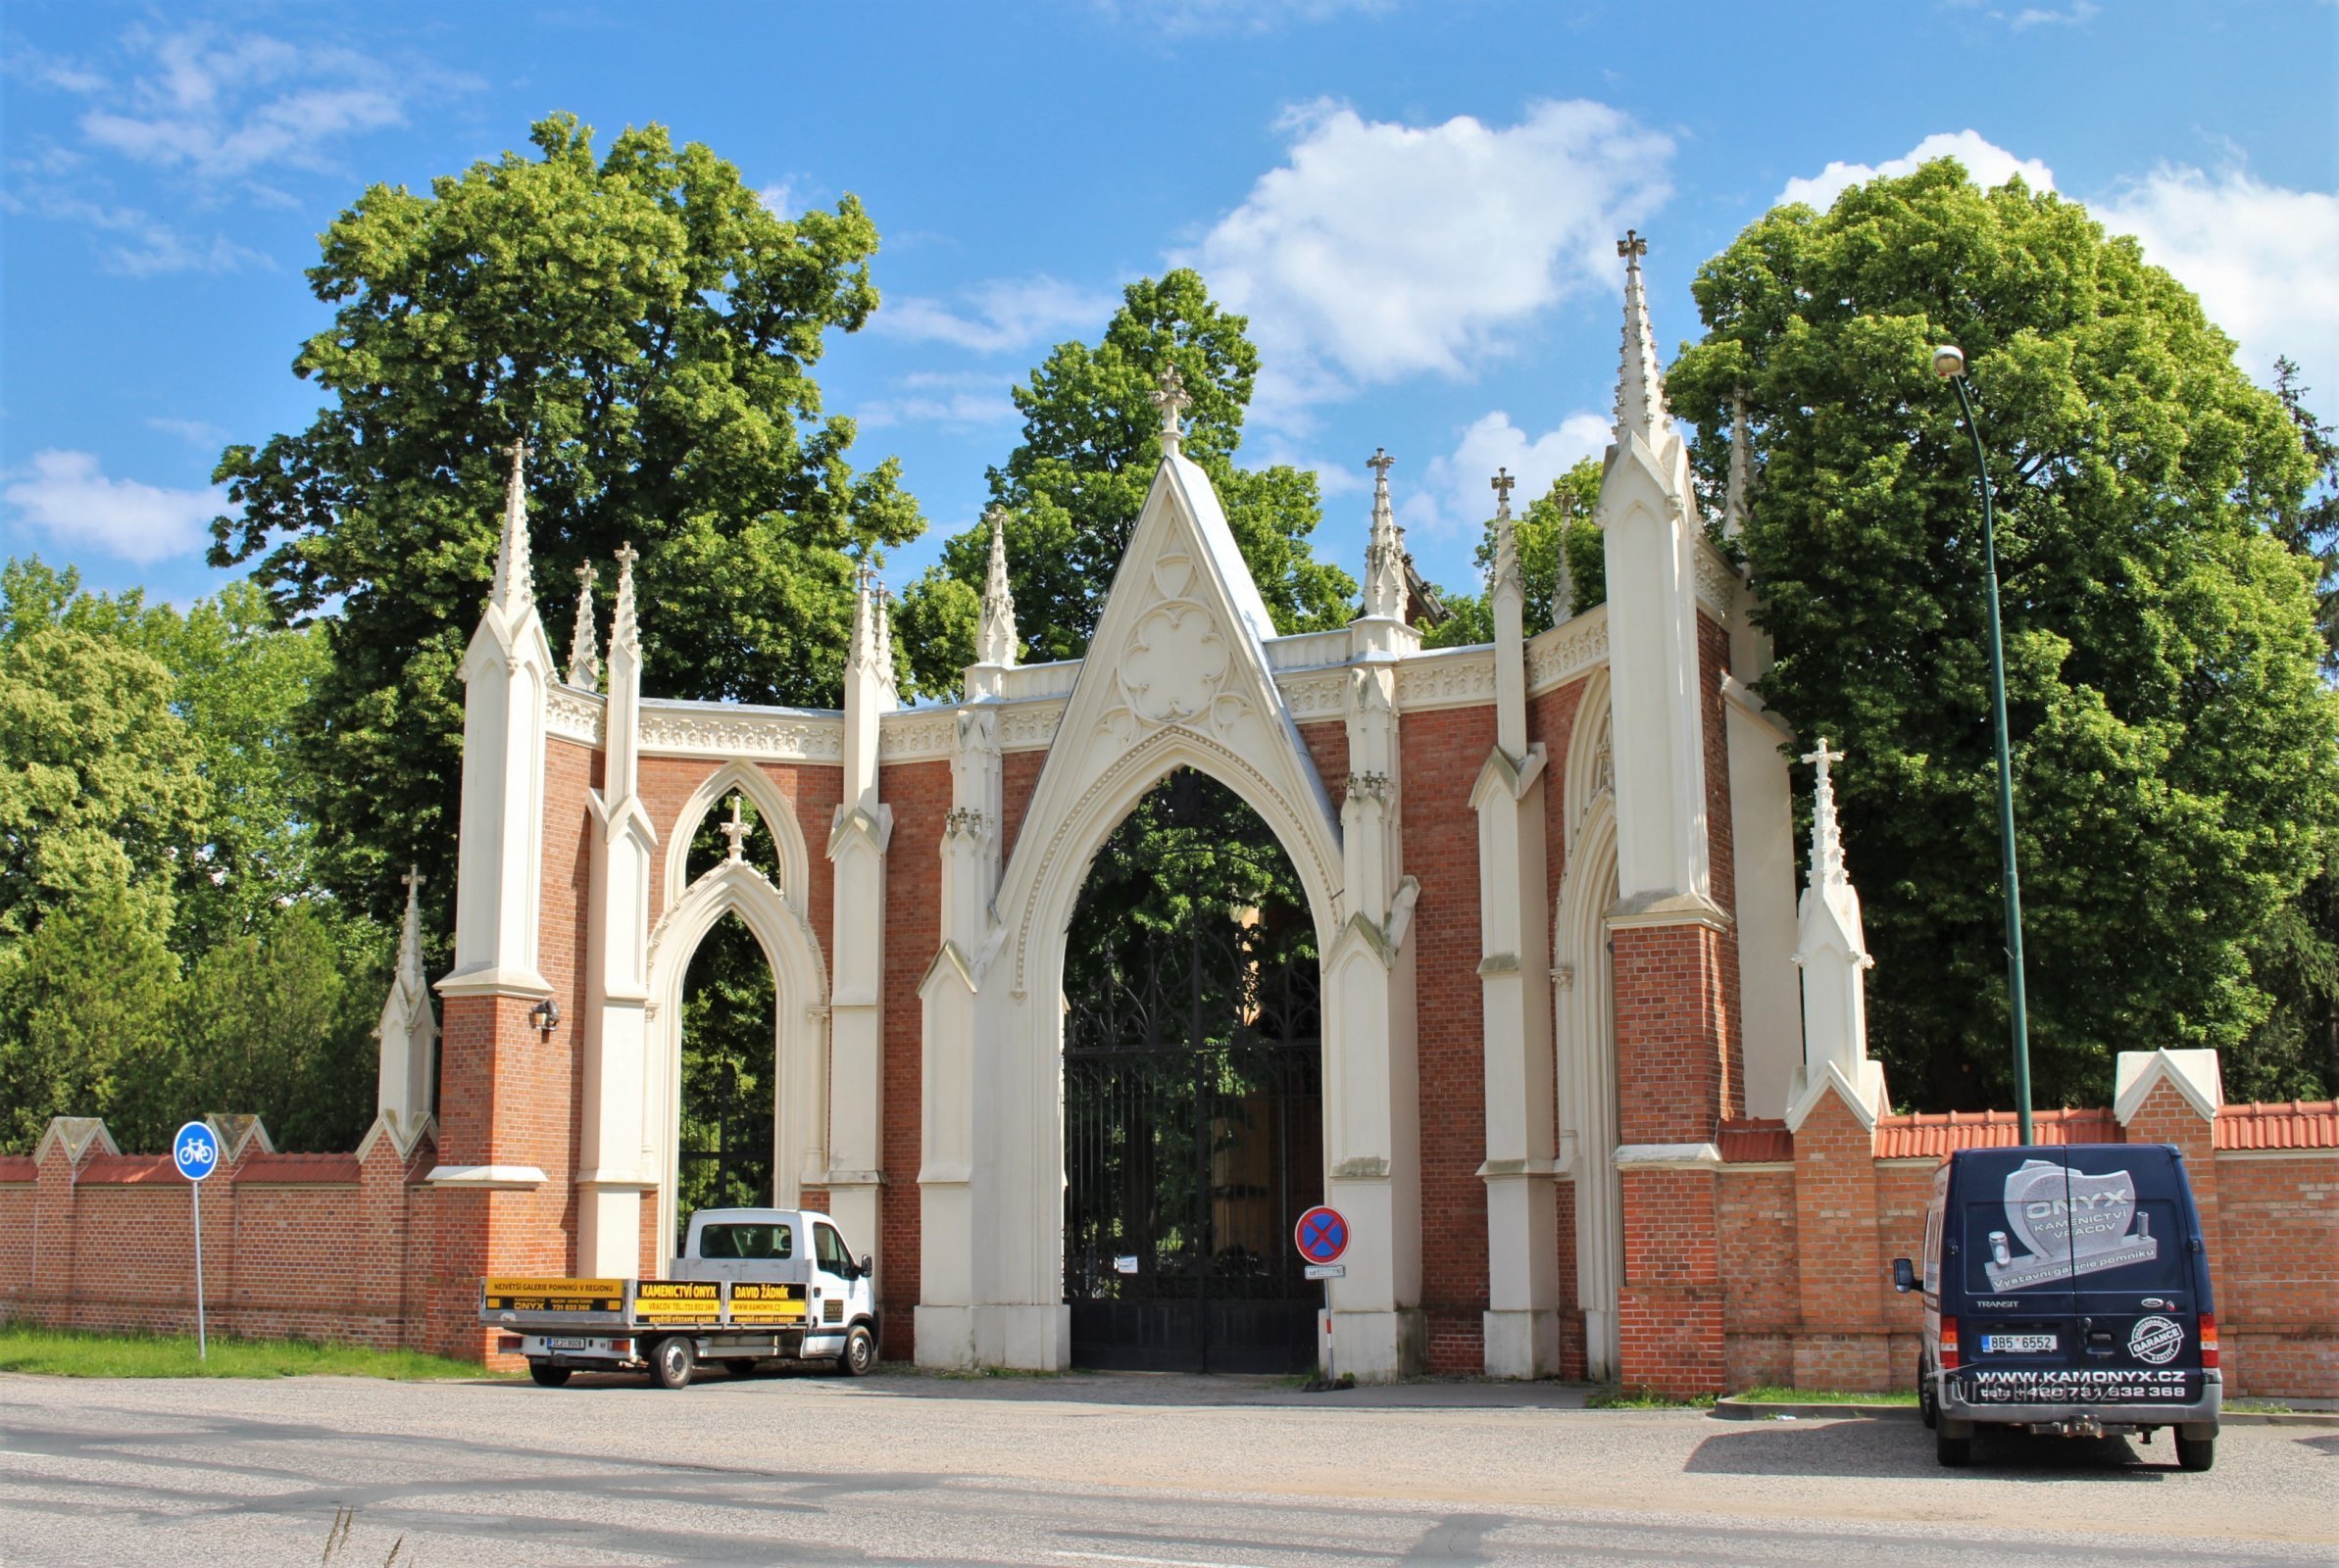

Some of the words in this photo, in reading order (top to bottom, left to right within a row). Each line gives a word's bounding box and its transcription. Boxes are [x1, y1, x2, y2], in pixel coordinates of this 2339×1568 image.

[2025, 1189, 2128, 1219] ONYX
[2054, 1223, 2116, 1239] VRACOV
[2053, 1261, 2097, 1277] galerie
[523, 1283, 547, 1292] GALERIE
[641, 1283, 693, 1298] KAMENICTVÍ
[693, 1285, 717, 1298] ONYX
[734, 1286, 760, 1298] DAVID
[761, 1284, 789, 1299] ŽÁDNÍK
[1991, 1337, 2014, 1348] 8B5
[2021, 1337, 2052, 1348] 6552
[2133, 1328, 2180, 1352] GARANCE
[1976, 1371, 2186, 1383] WWW.KAMONYX.CZ
[2016, 1388, 2064, 1397] +420
[2067, 1387, 2102, 1397] 731
[2106, 1387, 2146, 1397] 832
[2149, 1387, 2185, 1397] 368
